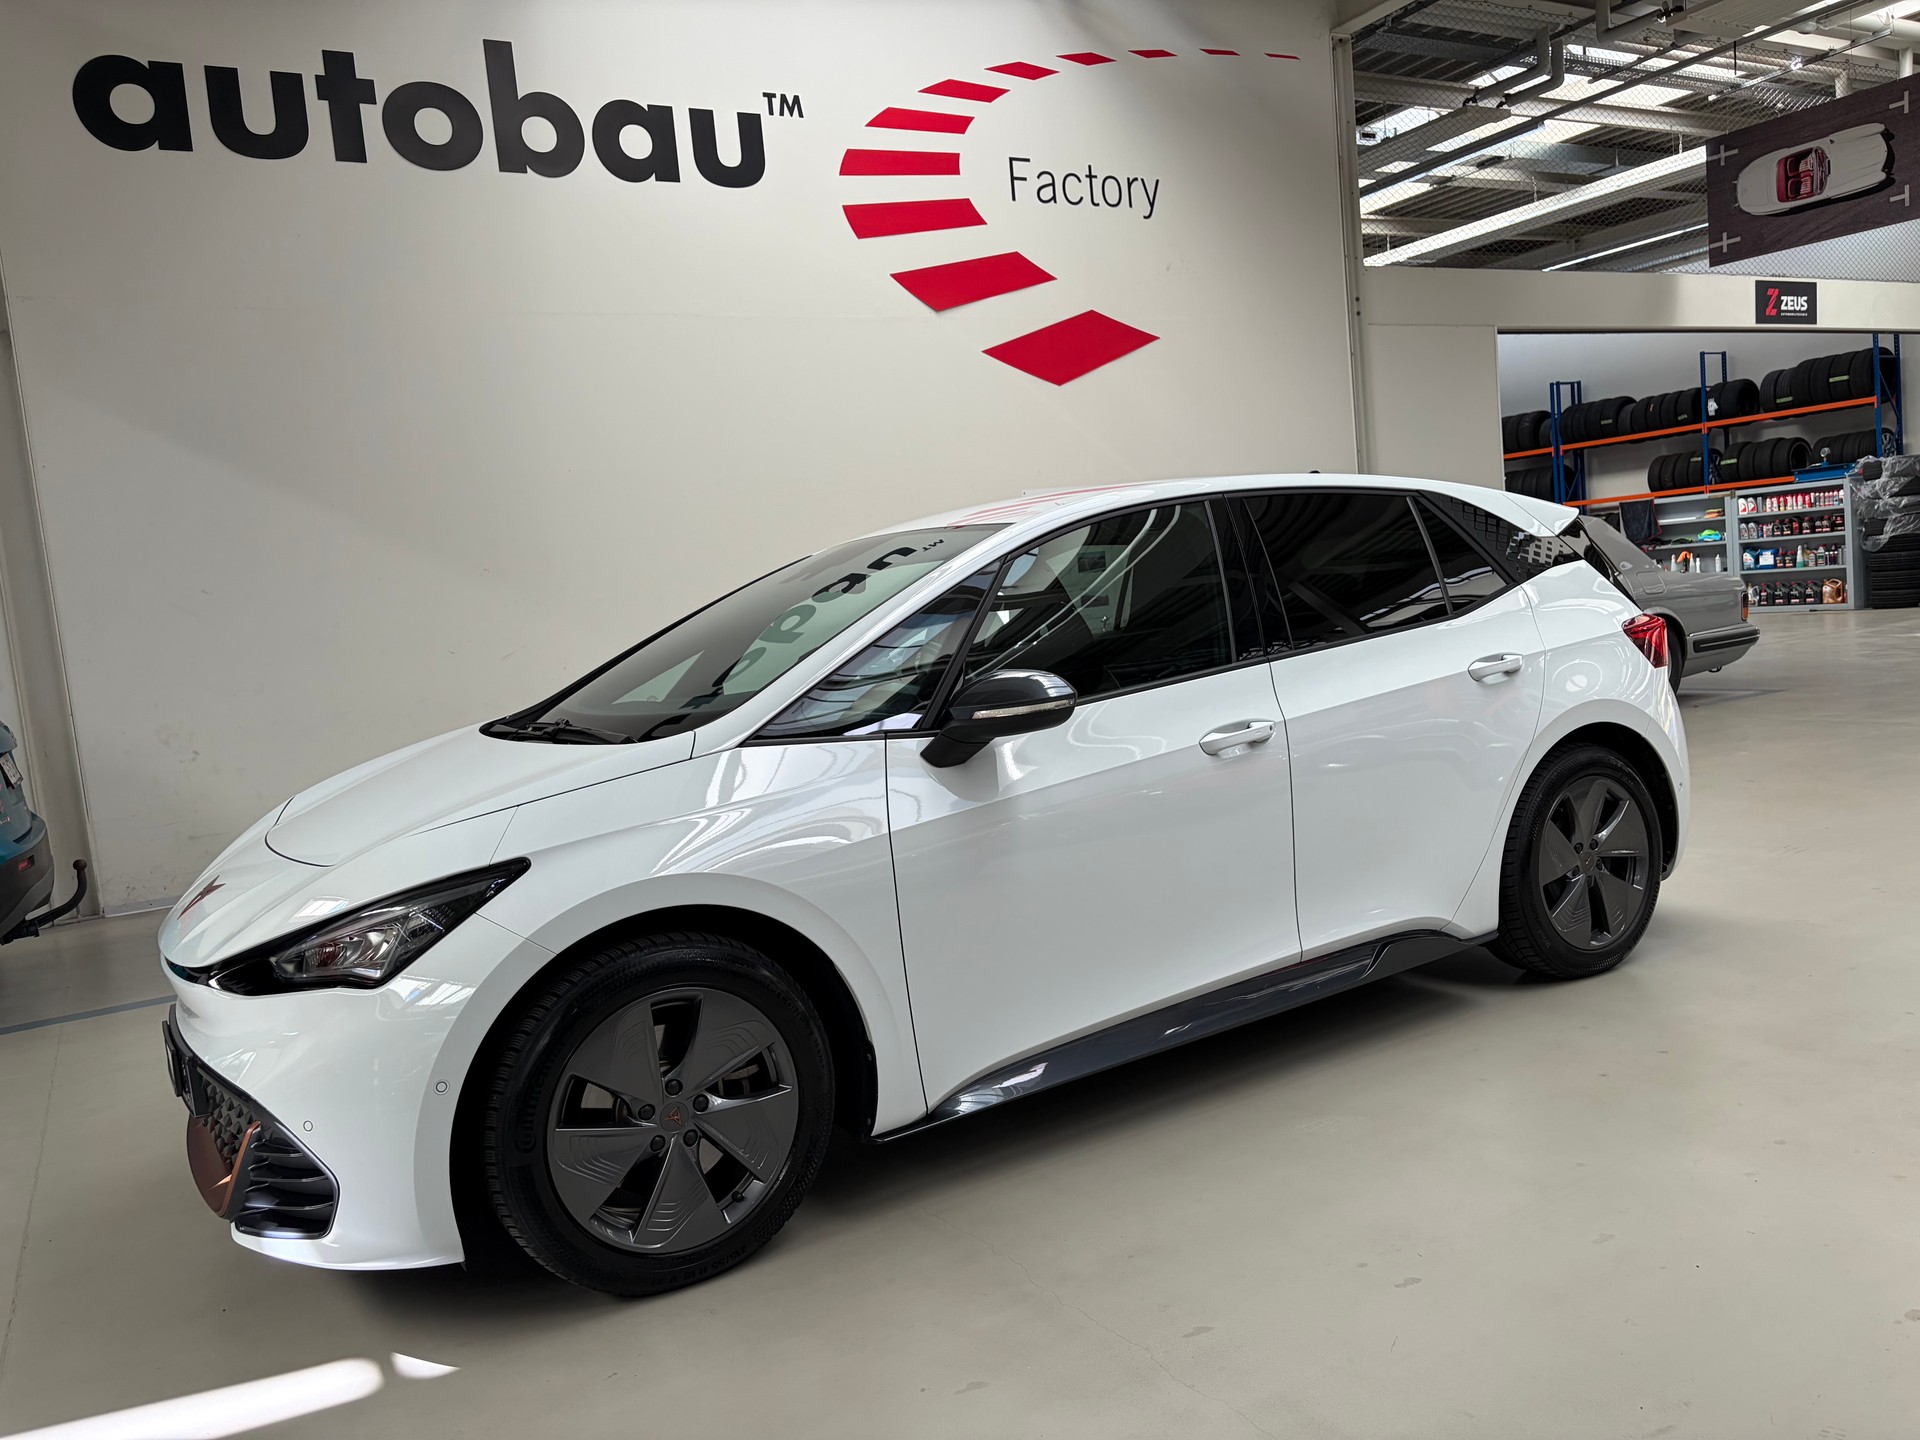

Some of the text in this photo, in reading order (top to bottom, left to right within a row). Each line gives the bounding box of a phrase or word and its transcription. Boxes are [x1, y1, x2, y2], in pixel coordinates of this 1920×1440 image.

[72, 38, 804, 188] autobau TM
[1008, 156, 1160, 220] Factory
[1780, 295, 1808, 311] ZEUS
